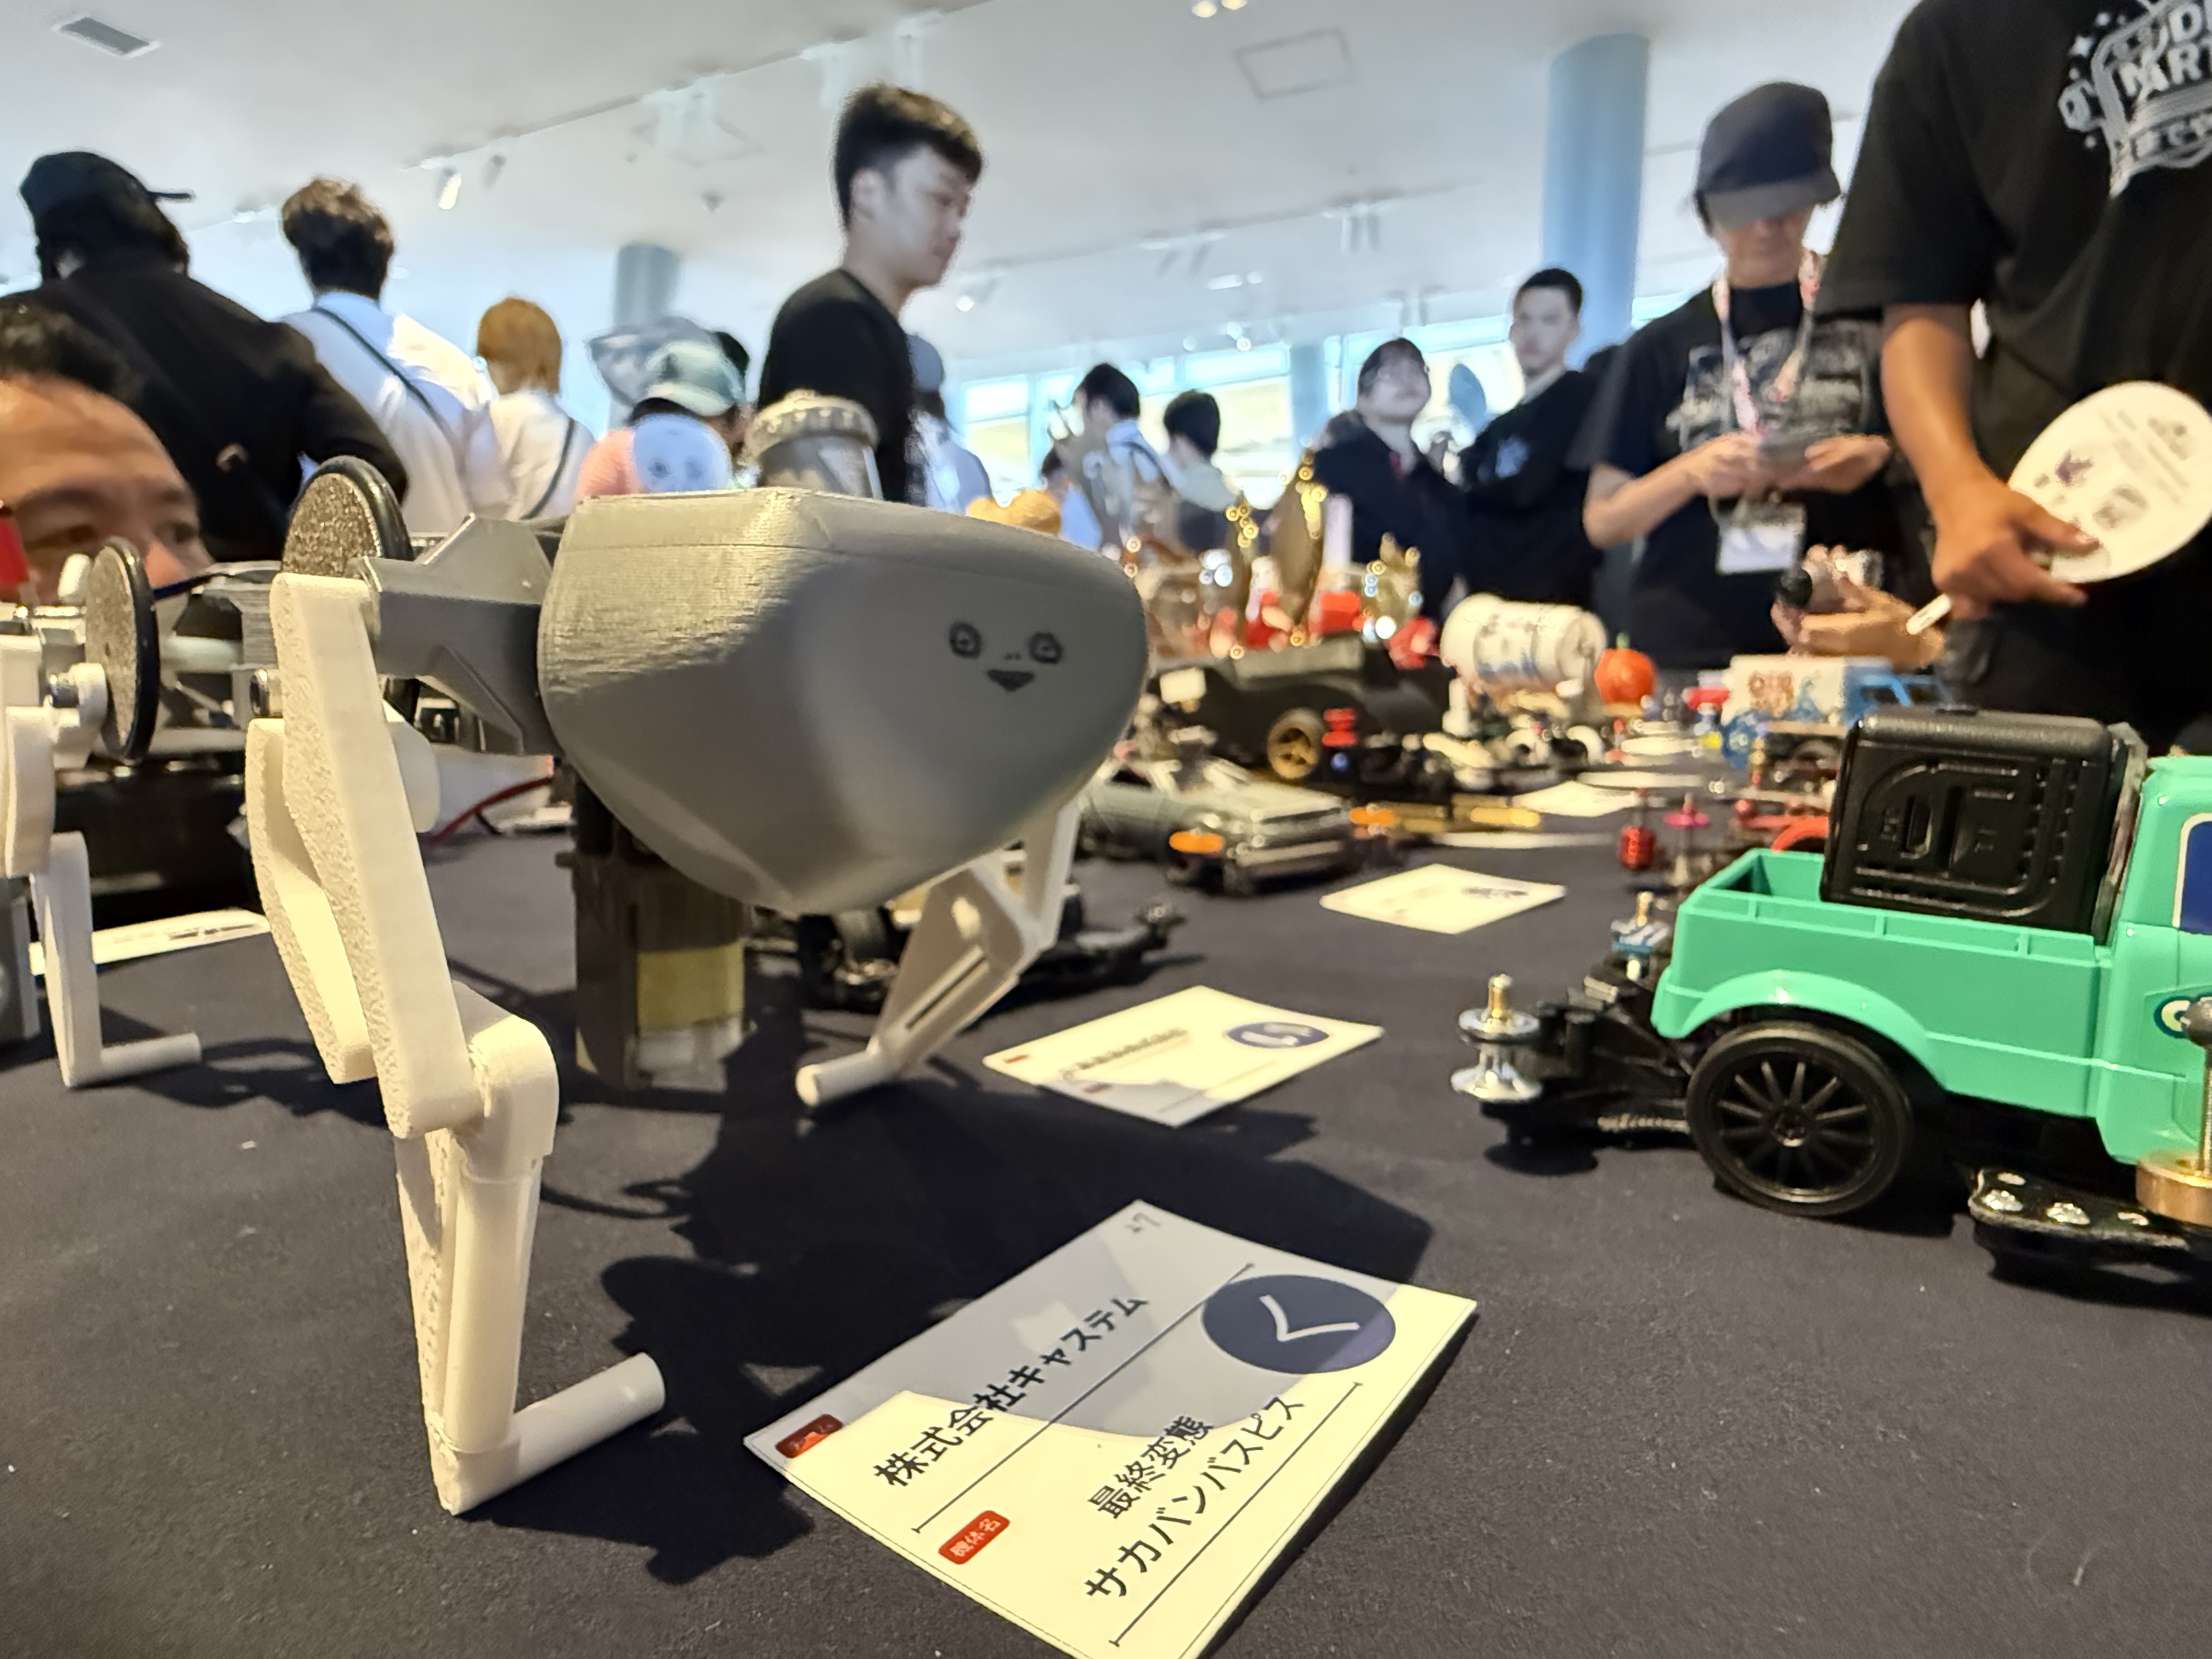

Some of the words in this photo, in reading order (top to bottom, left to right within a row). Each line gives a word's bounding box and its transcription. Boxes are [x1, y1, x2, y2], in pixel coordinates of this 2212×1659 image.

[873, 1297, 1149, 1487] 株式会社キャステム
[949, 1518, 1002, 1558] 機体名
[1084, 1396, 1305, 1598] サカバンバスピス
[1087, 1415, 1215, 1519] 最終変態
